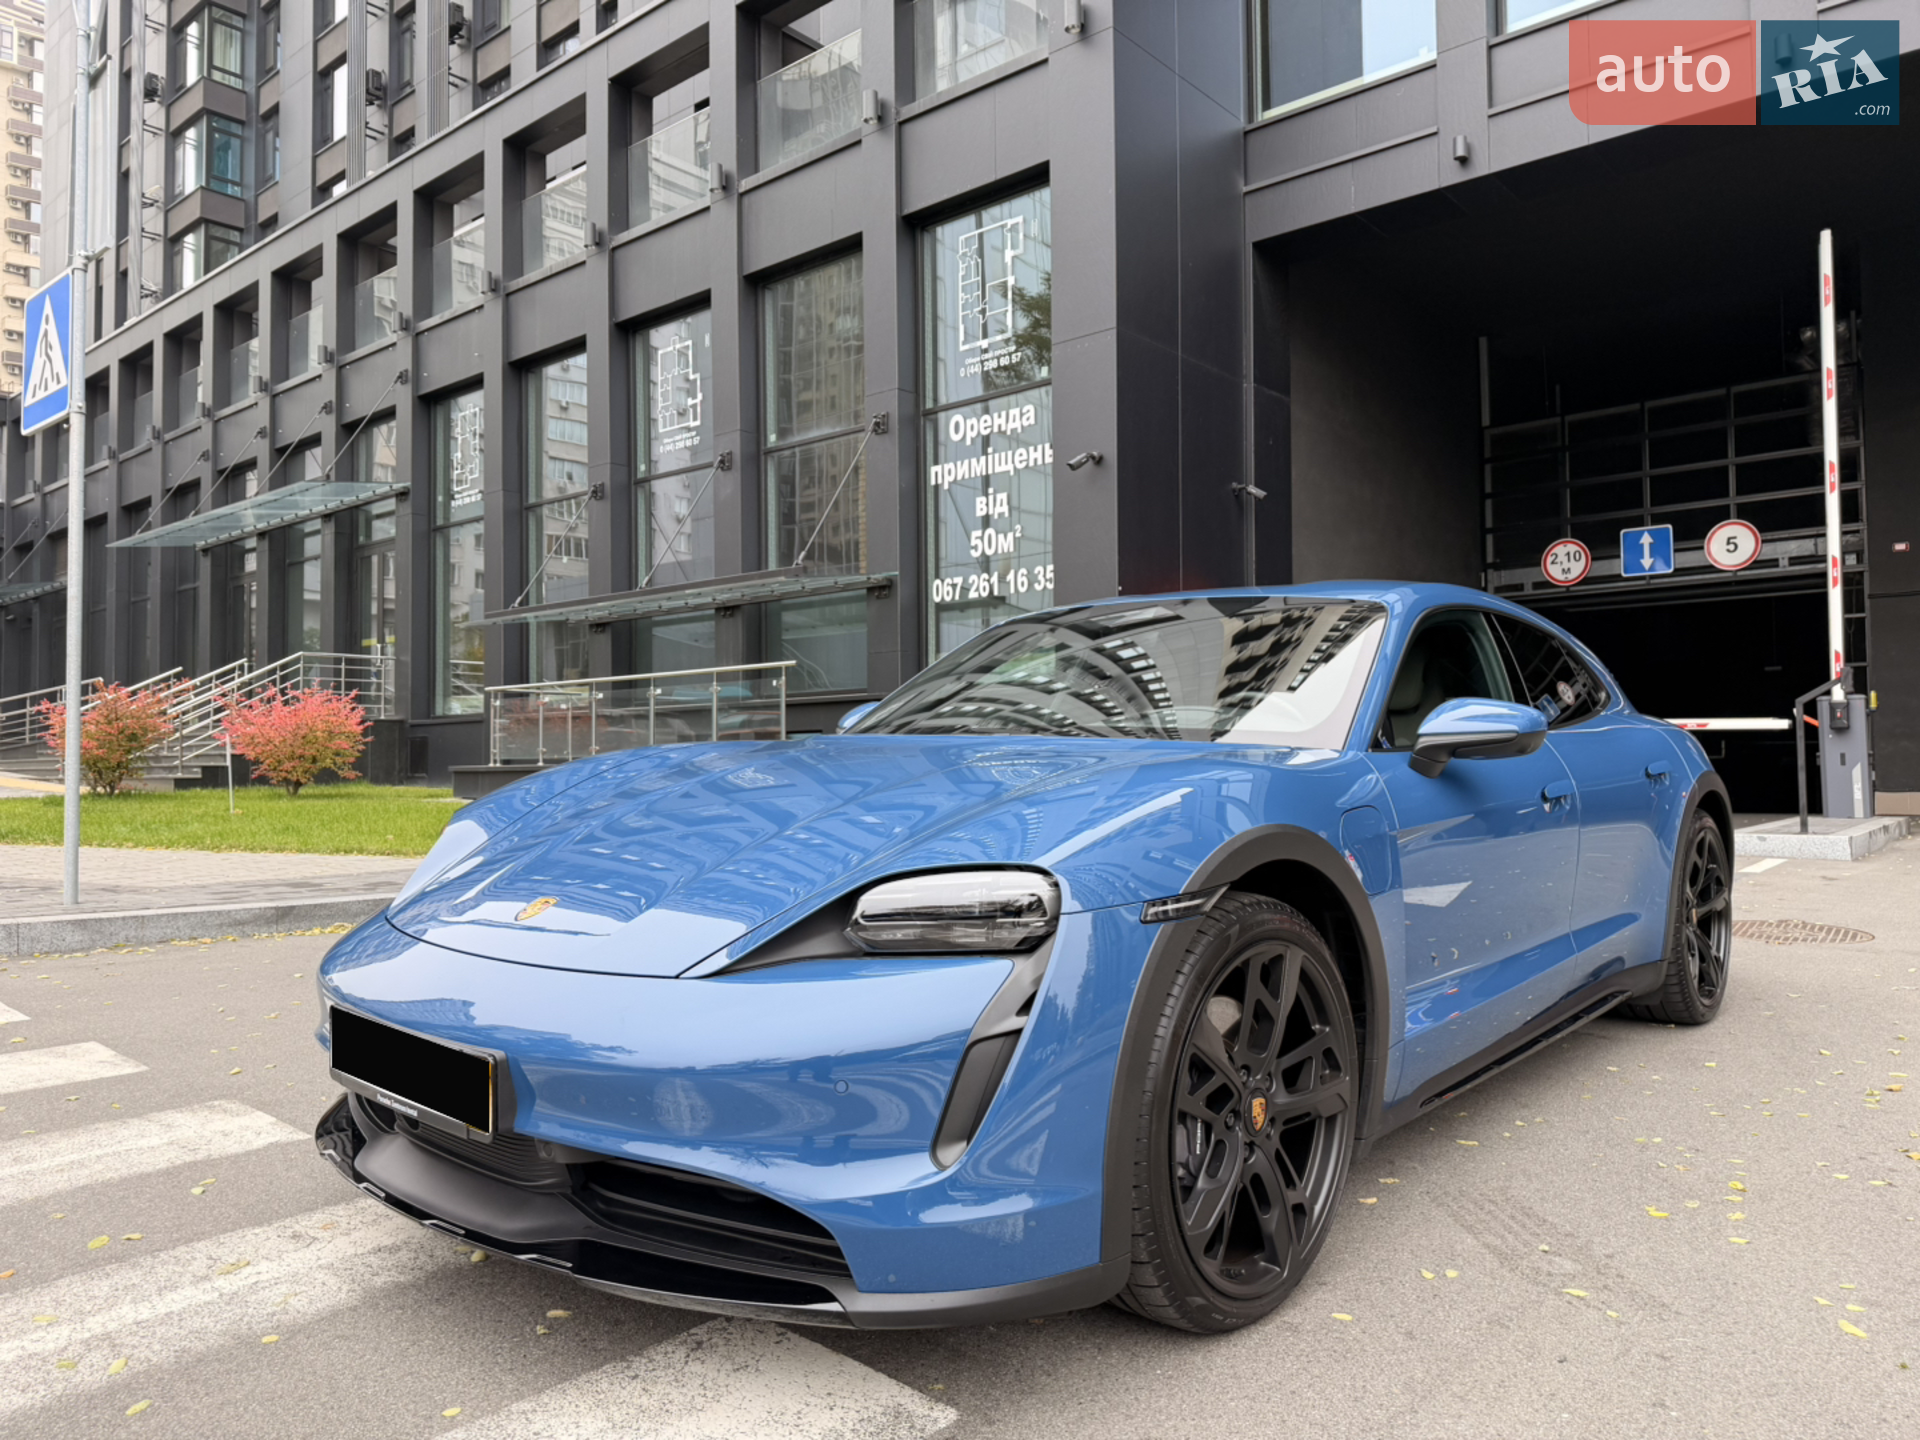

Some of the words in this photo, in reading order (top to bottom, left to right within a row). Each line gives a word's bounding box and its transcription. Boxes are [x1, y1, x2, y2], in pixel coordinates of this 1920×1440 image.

[1011, 352, 1022, 363] 57
[949, 404, 1036, 446] Оренда
[930, 442, 1054, 490] приміщень
[975, 487, 1009, 519] від
[1549, 550, 1582, 567] 2,10
[1725, 536, 1739, 553] 5
[932, 576, 963, 603] 067
[968, 571, 999, 599] 261
[1006, 568, 1029, 594] 16
[1034, 564, 1054, 591] 35
